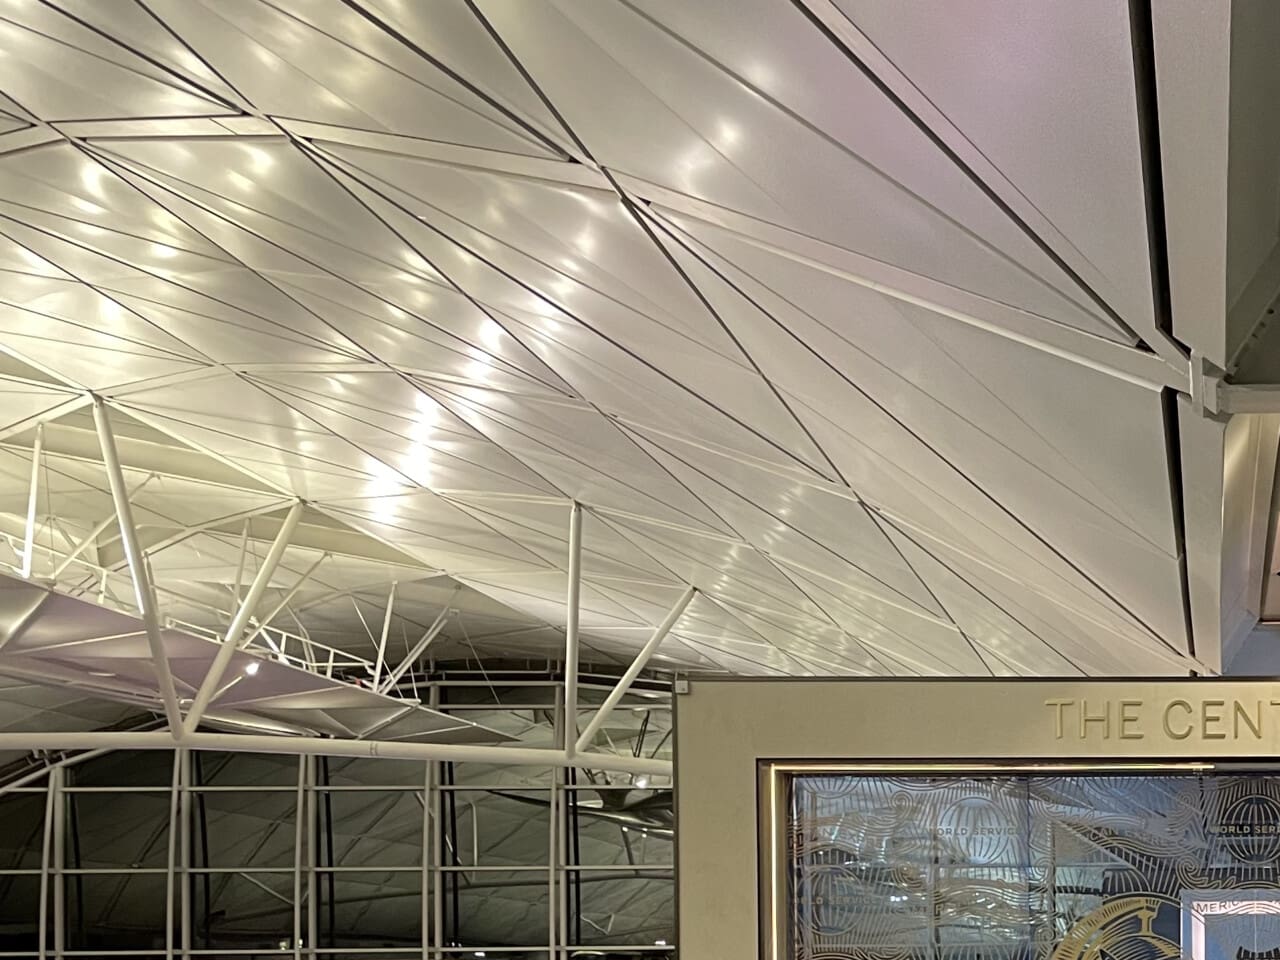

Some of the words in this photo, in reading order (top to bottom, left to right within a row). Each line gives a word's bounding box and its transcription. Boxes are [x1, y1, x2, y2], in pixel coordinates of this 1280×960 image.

[1044, 699, 1144, 740] THE
[935, 826, 969, 836] ORLD
[1210, 825, 1250, 835] WORLD
